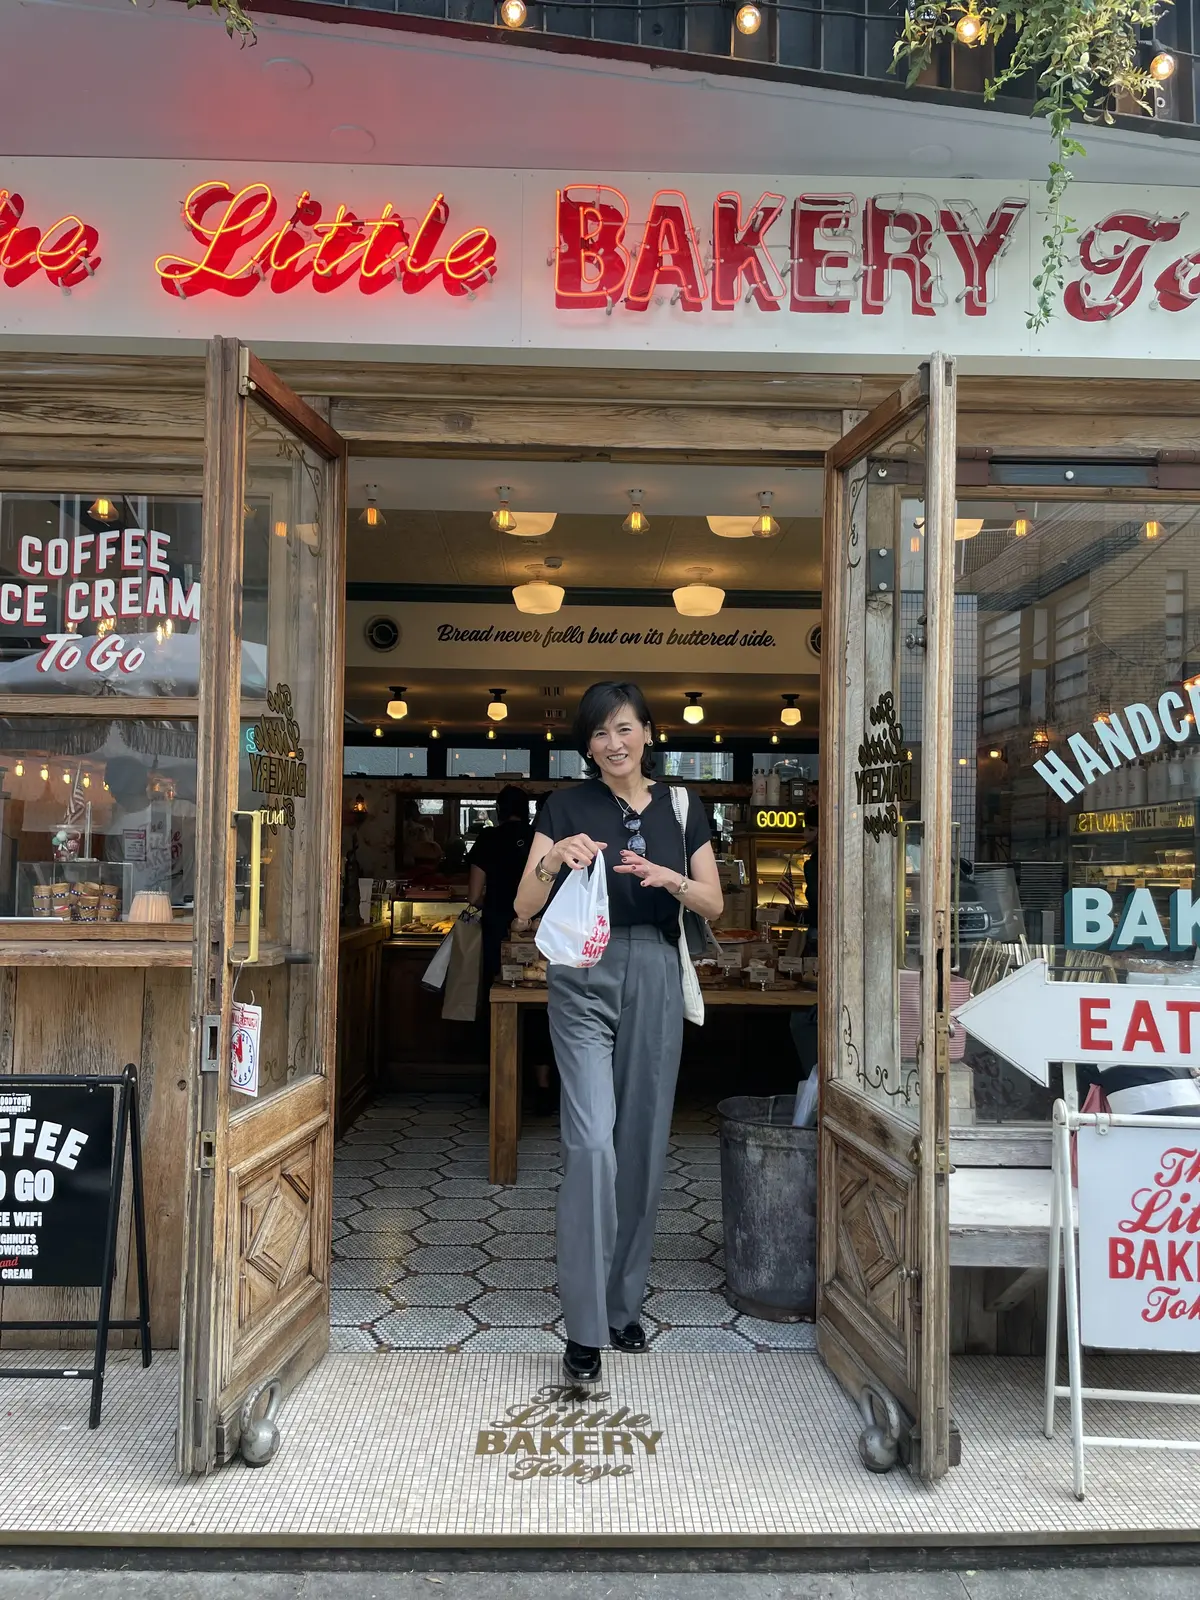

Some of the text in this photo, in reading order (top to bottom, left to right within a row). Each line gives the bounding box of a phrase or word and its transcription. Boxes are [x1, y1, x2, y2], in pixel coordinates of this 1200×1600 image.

[155, 181, 498, 298] Little
[553, 184, 1030, 314] BAKERY
[18, 528, 171, 580] COFFEE
[65, 576, 200, 624] CREAM
[437, 624, 776, 649] Bread never falls but on its buttered side.
[36, 634, 146, 673] To Go
[756, 810, 797, 828] GOOD
[1080, 997, 1200, 1054] EAT
[14, 1169, 55, 1202] GO
[13, 1211, 42, 1227] WiFi
[1, 1268, 33, 1279] CREAM
[1108, 1236, 1200, 1282] BAK
[530, 1384, 612, 1404] The
[489, 1404, 652, 1428] Little
[474, 1430, 665, 1456] BAKERY
[508, 1456, 635, 1485] Tokyo
